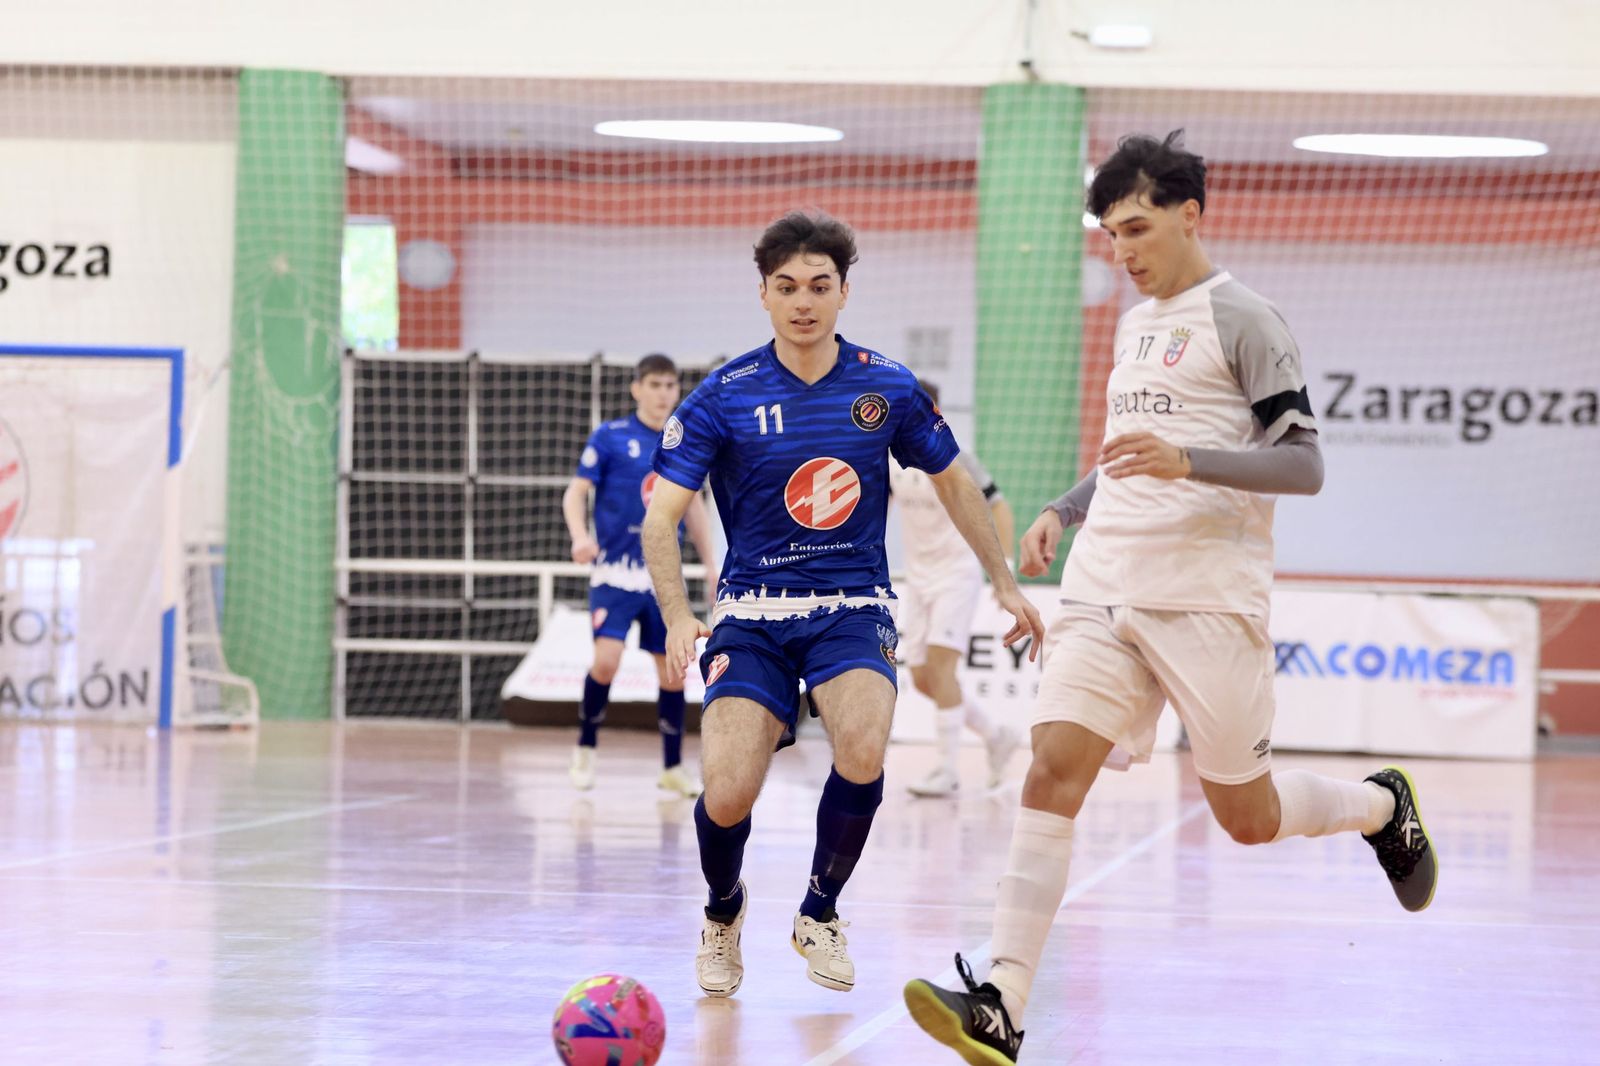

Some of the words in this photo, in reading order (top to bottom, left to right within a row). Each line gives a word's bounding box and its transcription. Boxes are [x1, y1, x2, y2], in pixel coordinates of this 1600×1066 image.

[1135, 336, 1155, 360] 17
[754, 404, 784, 435] 11
[1324, 371, 1600, 443] Zaragoza
[1325, 642, 1515, 686] COMEZA
